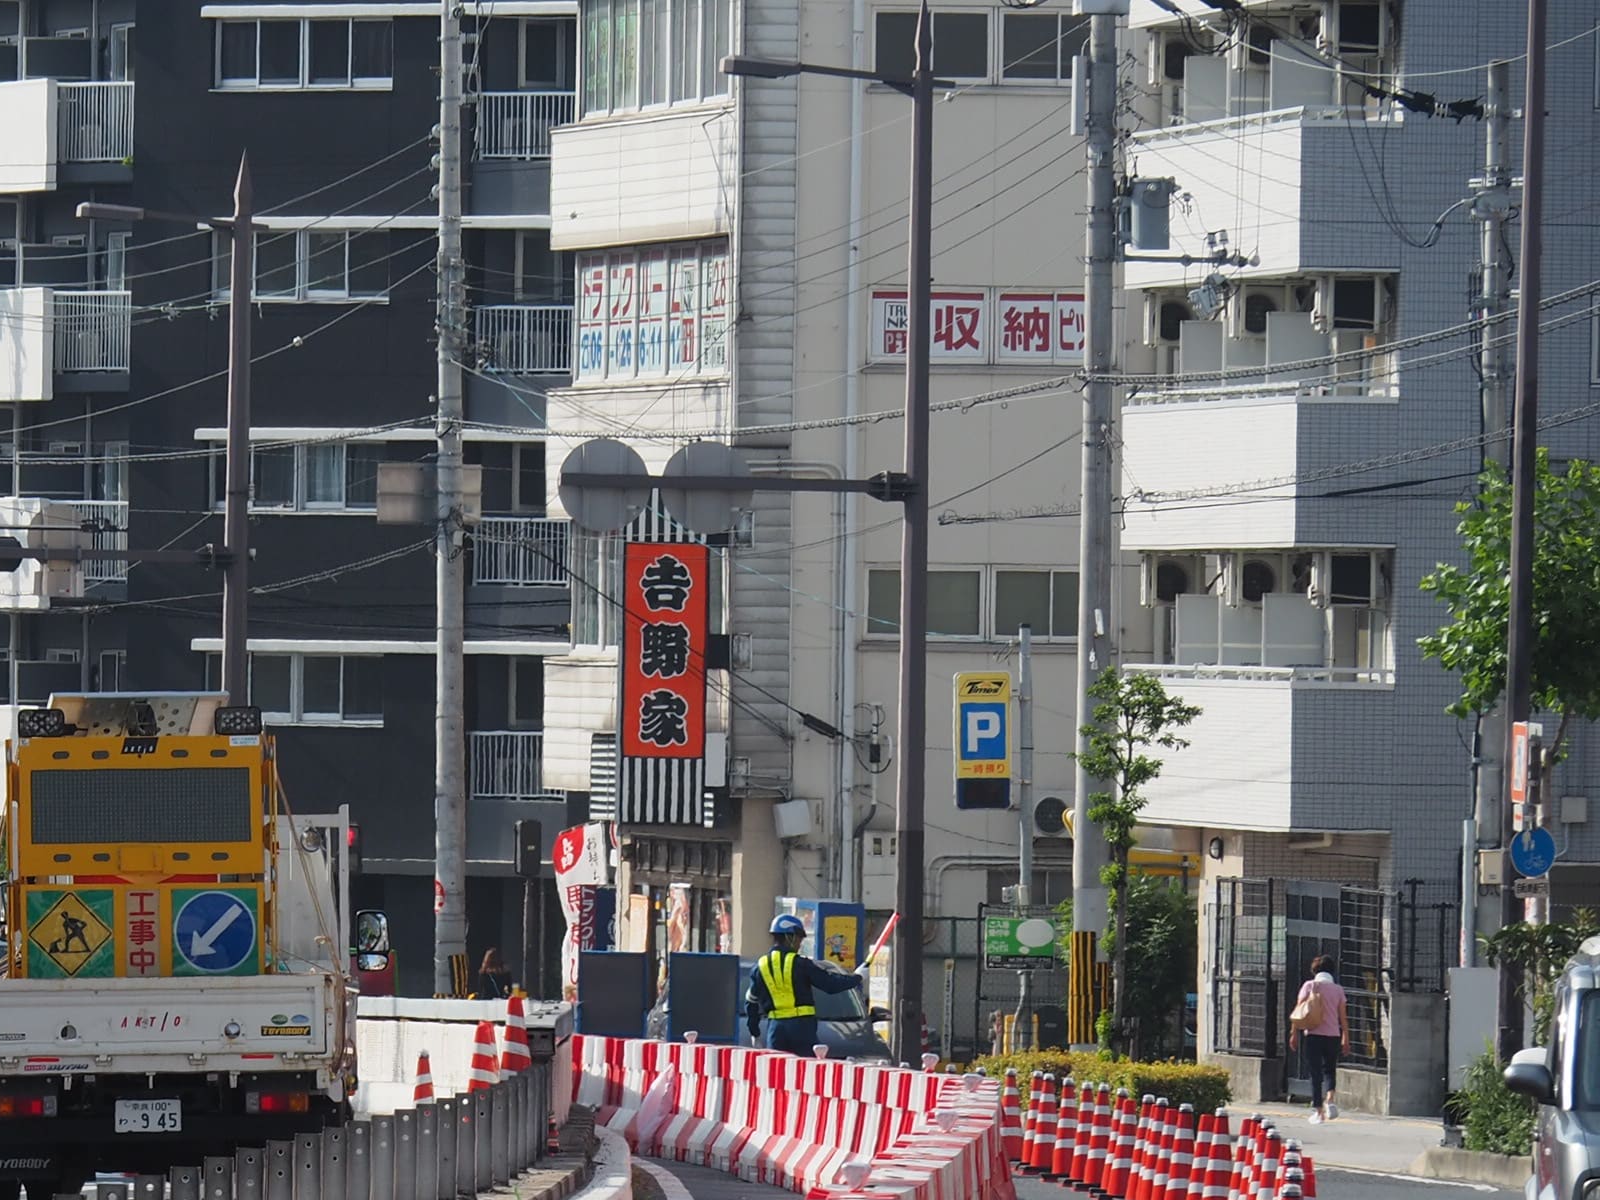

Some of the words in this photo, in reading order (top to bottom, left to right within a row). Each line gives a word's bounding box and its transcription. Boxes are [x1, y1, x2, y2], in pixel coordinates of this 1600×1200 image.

[640, 554, 693, 748] 吉野家
[966, 681, 1003, 695] Times
[967, 711, 1000, 752] P
[129, 892, 156, 975] 工事中
